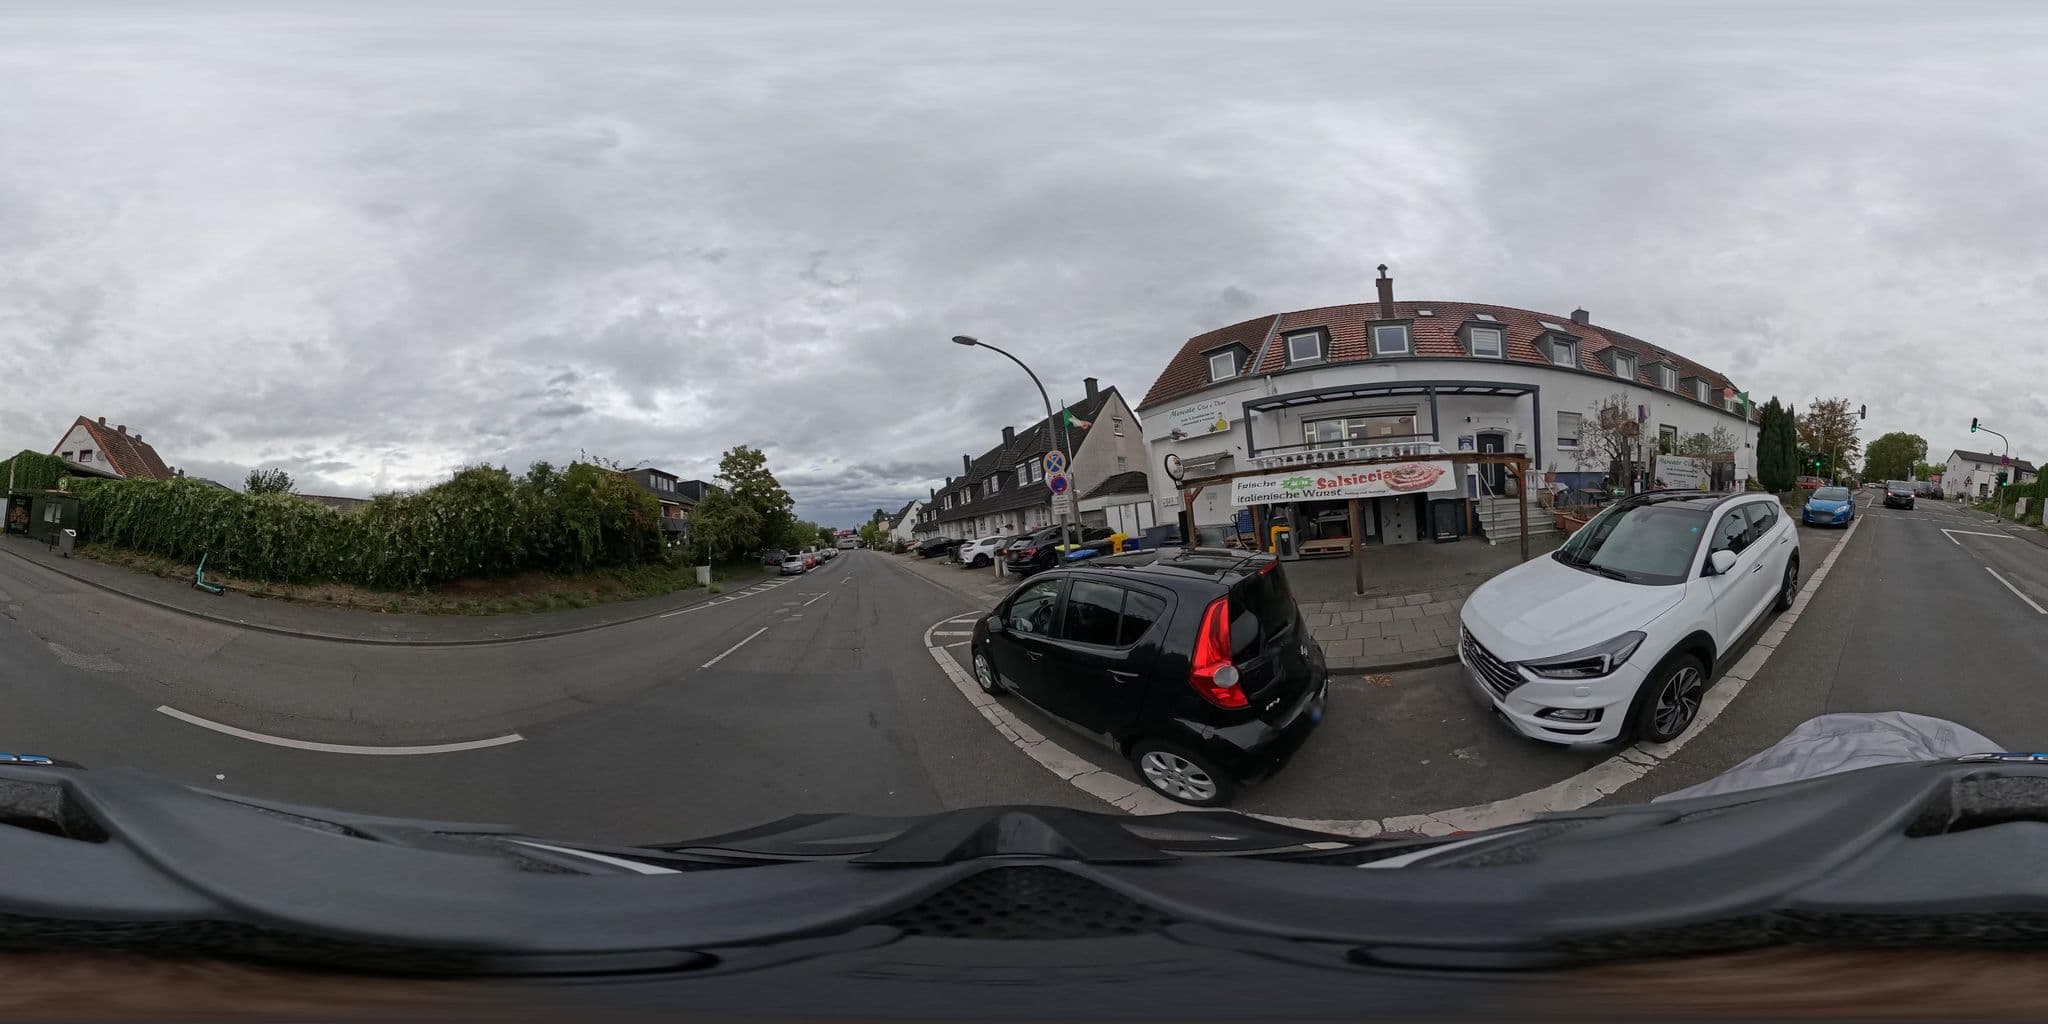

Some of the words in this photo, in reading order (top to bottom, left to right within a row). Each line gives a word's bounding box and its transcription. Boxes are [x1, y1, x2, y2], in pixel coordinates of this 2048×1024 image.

[1237, 480, 1277, 491] Frische
[1316, 469, 1394, 490] Salsiccia
[1237, 490, 1300, 504] italienische
[1302, 489, 1343, 499] Wurst
